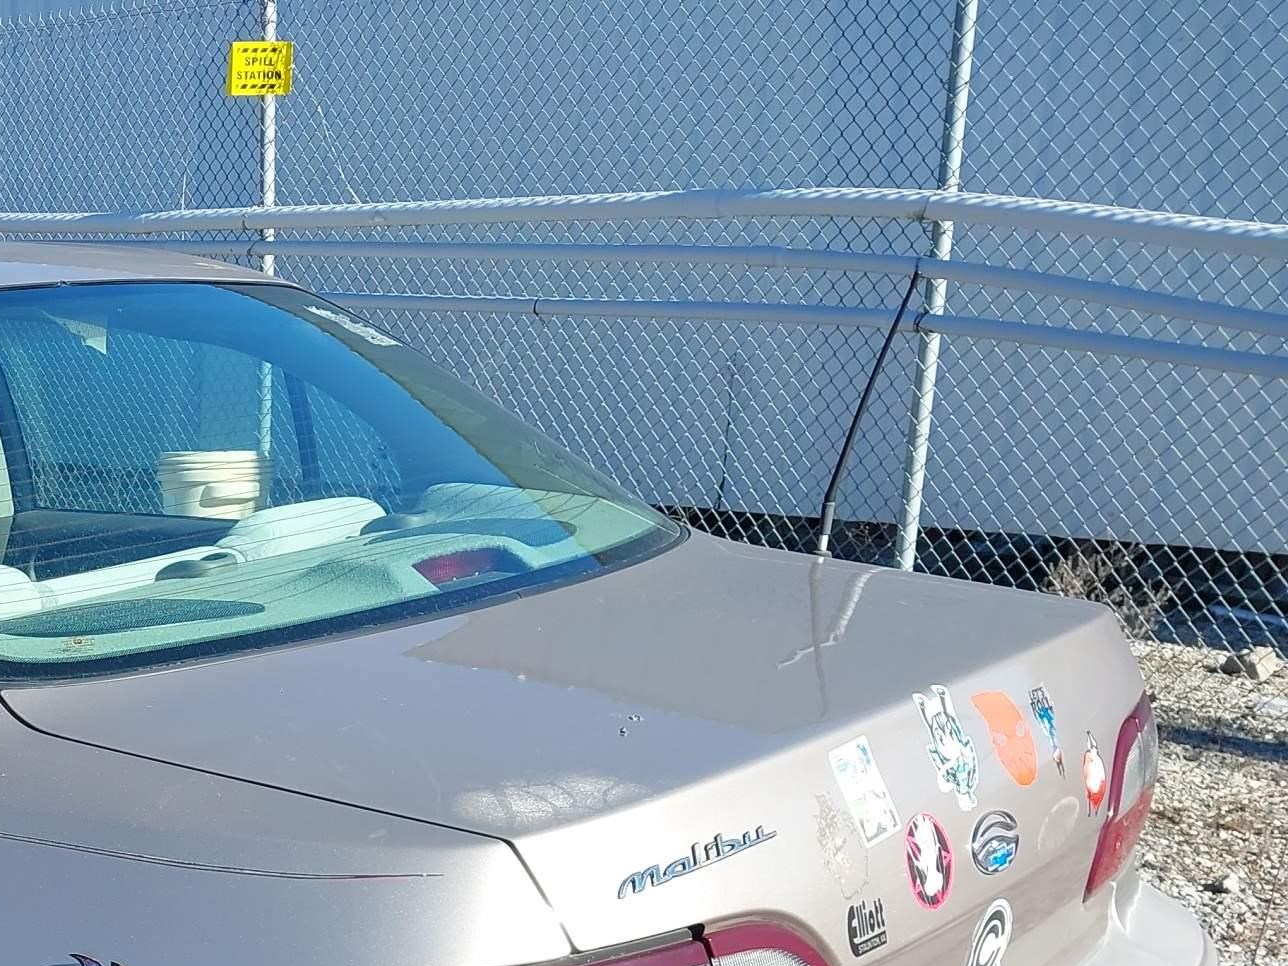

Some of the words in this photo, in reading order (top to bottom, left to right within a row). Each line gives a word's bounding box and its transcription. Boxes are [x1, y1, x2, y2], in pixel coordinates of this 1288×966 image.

[244, 57, 275, 66] SPILL
[236, 71, 282, 80] STATION
[617, 825, 777, 899] Malibu
[848, 898, 885, 940] Elliott
